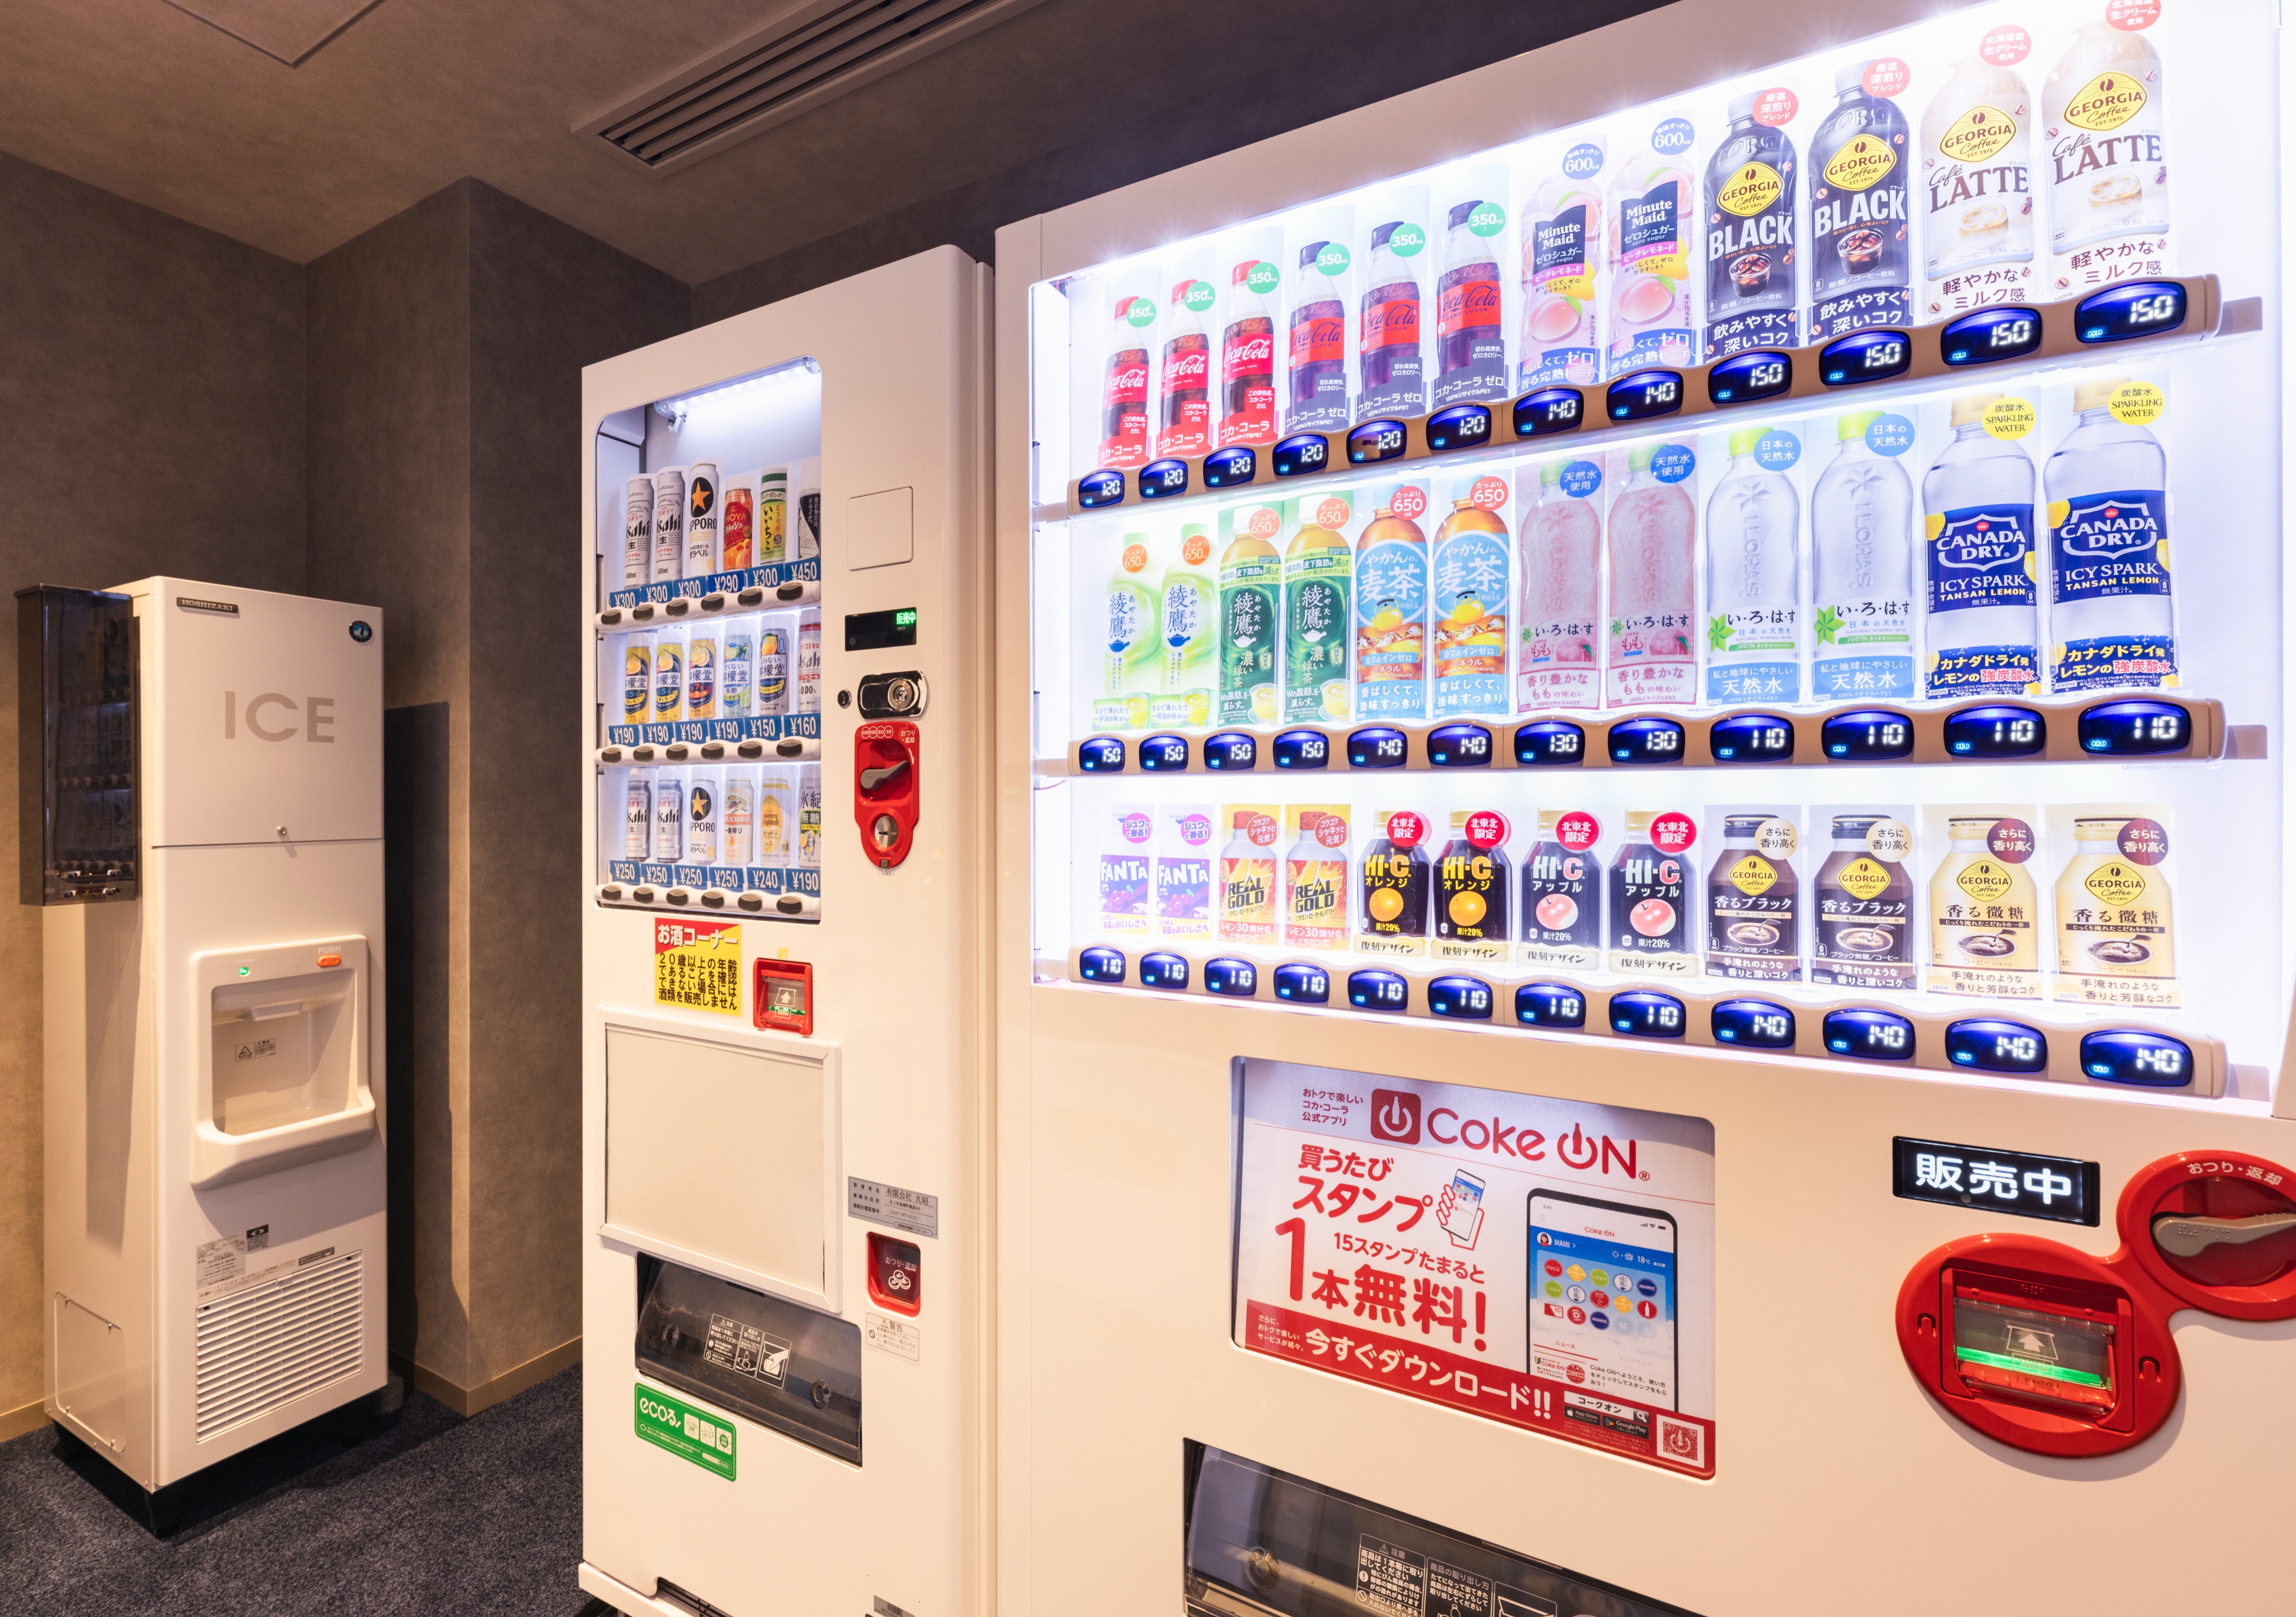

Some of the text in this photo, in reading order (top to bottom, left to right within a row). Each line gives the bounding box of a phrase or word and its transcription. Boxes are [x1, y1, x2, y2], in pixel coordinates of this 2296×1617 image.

[2069, 91, 2142, 117] GEORGIA
[2052, 133, 2092, 158] Café
[2054, 135, 2162, 186] LATTE
[1843, 166, 1879, 182] Coffee
[1626, 200, 1672, 220] Minute
[1814, 190, 1906, 239] BLACK
[1471, 213, 1504, 227] 350ml
[1631, 212, 1668, 229] Maid
[1623, 226, 1675, 243] ゼロシュガー
[1624, 244, 1674, 262] ピーチレモネード
[2071, 240, 2154, 271] 軽やかな
[2085, 260, 2162, 284] ミルク感
[1820, 290, 1902, 321] 飲みやすく
[2130, 295, 2173, 323] 150
[1446, 312, 1462, 321] ZERO
[1832, 309, 1903, 335] 深いコク
[1611, 332, 1690, 360] おいしくて、ゼロ
[1610, 350, 1690, 374] 香る完熟ピーチ
[1435, 376, 1504, 399] コカ・コーラ ゼロ
[2121, 388, 2153, 398] 炭酸水
[1548, 400, 1576, 420] 140
[2112, 399, 2162, 410] SPARKLING
[2121, 407, 2155, 418] WATER
[1221, 421, 1269, 439] コカ・コーラ
[1378, 431, 1401, 449] 120
[1873, 434, 1909, 448] 天然水
[1165, 469, 1183, 485] 120
[1474, 489, 1505, 502] 650
[764, 506, 772, 550] いいちこ
[2060, 517, 2157, 539] CANADA
[2088, 531, 2135, 547] DRY
[791, 561, 817, 580] ¥450
[1436, 555, 1506, 597] 麦茶
[2065, 562, 2159, 582] ICY SPARK
[679, 580, 701, 597] ¥300
[714, 575, 738, 592] ¥290
[2066, 576, 2159, 591] TANSAN LEMON
[614, 592, 635, 608] ¥300
[646, 586, 668, 602] ¥300
[182, 599, 233, 611] HOSHIZAKI
[1168, 585, 1189, 633] 綾鷹
[1323, 588, 1332, 625] あやたか
[1837, 600, 1910, 617] い・ろ・は・す
[897, 612, 916, 625] 販売中
[1444, 646, 1494, 657] カフェインゼロ
[2068, 645, 2165, 662] カナダドライ発
[1819, 659, 1908, 673] 私と地球にやさしい
[2060, 659, 2171, 679] レモンの強炭酸水
[1618, 667, 1685, 683] 香り豊かな
[1831, 670, 1897, 690] 天然水
[1439, 678, 1501, 694] 香ばしくて、
[1437, 693, 1503, 708] 後味すっきり
[225, 691, 334, 743] ICE
[647, 725, 669, 743] ¥190
[715, 721, 739, 739] ¥190
[751, 719, 775, 737] ¥150
[790, 717, 816, 736] ¥160
[1869, 724, 1903, 745] 110
[1378, 739, 1402, 756] 140
[1550, 735, 1577, 752] 130
[1647, 731, 1677, 749] 130
[1102, 746, 1121, 763] 150
[1302, 741, 1324, 758] 150
[615, 863, 635, 880] ¥250
[714, 870, 738, 887] ¥250
[753, 871, 778, 888] ¥240
[1158, 863, 1209, 886] FANTA
[792, 873, 818, 891] ¥190
[1295, 879, 1334, 898] REAL
[1444, 880, 1490, 891] オレンジ
[2089, 880, 2142, 889] GEORGIA
[1625, 885, 1679, 898] アップル
[1295, 893, 1335, 914] GOLD
[1822, 899, 1907, 915] 香るブラック
[2073, 909, 2159, 925] 香る微糖
[658, 924, 738, 949] お酒コーナー
[1289, 927, 1342, 939] レモン30個分の
[1457, 928, 1483, 938] 果汁20%
[318, 945, 340, 954] PUSH
[1442, 945, 1498, 959] 復刻デザイン
[660, 953, 737, 972] 20歳以上の年齢
[1103, 959, 1122, 974] 110
[1832, 964, 1898, 977] 手淹れのような
[658, 965, 737, 985] であることを確認
[1837, 975, 1903, 988] 香りと深いコク
[658, 977, 737, 997] できない場合には
[1302, 976, 1325, 993] 110
[658, 988, 737, 1010] 酒類を販売しません
[2085, 991, 2172, 1004] 香りと芳醇なコク
[1648, 1006, 1678, 1026] 110
[1870, 1025, 1904, 1047] 140
[2137, 1049, 2180, 1073] 140
[1302, 1088, 1363, 1105] おトクで楽しい
[1302, 1101, 1349, 1115] コカ・コーラ
[1302, 1112, 1347, 1127] 公式アプリ
[1428, 1107, 1636, 1179] Coke ON
[1299, 1144, 1394, 1182] 買うたび
[1915, 1153, 2071, 1205] 販売中
[2187, 1161, 2283, 1186] おつり・返却
[853, 1182, 928, 1205] 管理者名 有限会社 丸昭
[853, 1193, 879, 1203] 連絡先住所
[853, 1203, 917, 1220] 連絡先電話番号 0197-67-4131
[1293, 1175, 1433, 1233] スタンプ
[1555, 1239, 1570, 1249] MAMI
[885, 1256, 916, 1271] おつり・返却
[1333, 1232, 1485, 1285] 15スタンプたまると
[1275, 1217, 1487, 1352] 1本無料!
[889, 1321, 903, 1332] 警告
[1305, 1328, 1552, 1420] 今すぐダウンロード!!
[1578, 1397, 1621, 1413] コークオン
[1616, 1421, 1635, 1430] Google
[1361, 1549, 1423, 1578] 商品は1本毎に取り
[1430, 1562, 1489, 1591] 商品の取り出し方
[1430, 1573, 1489, 1600] たてになって出てきた
